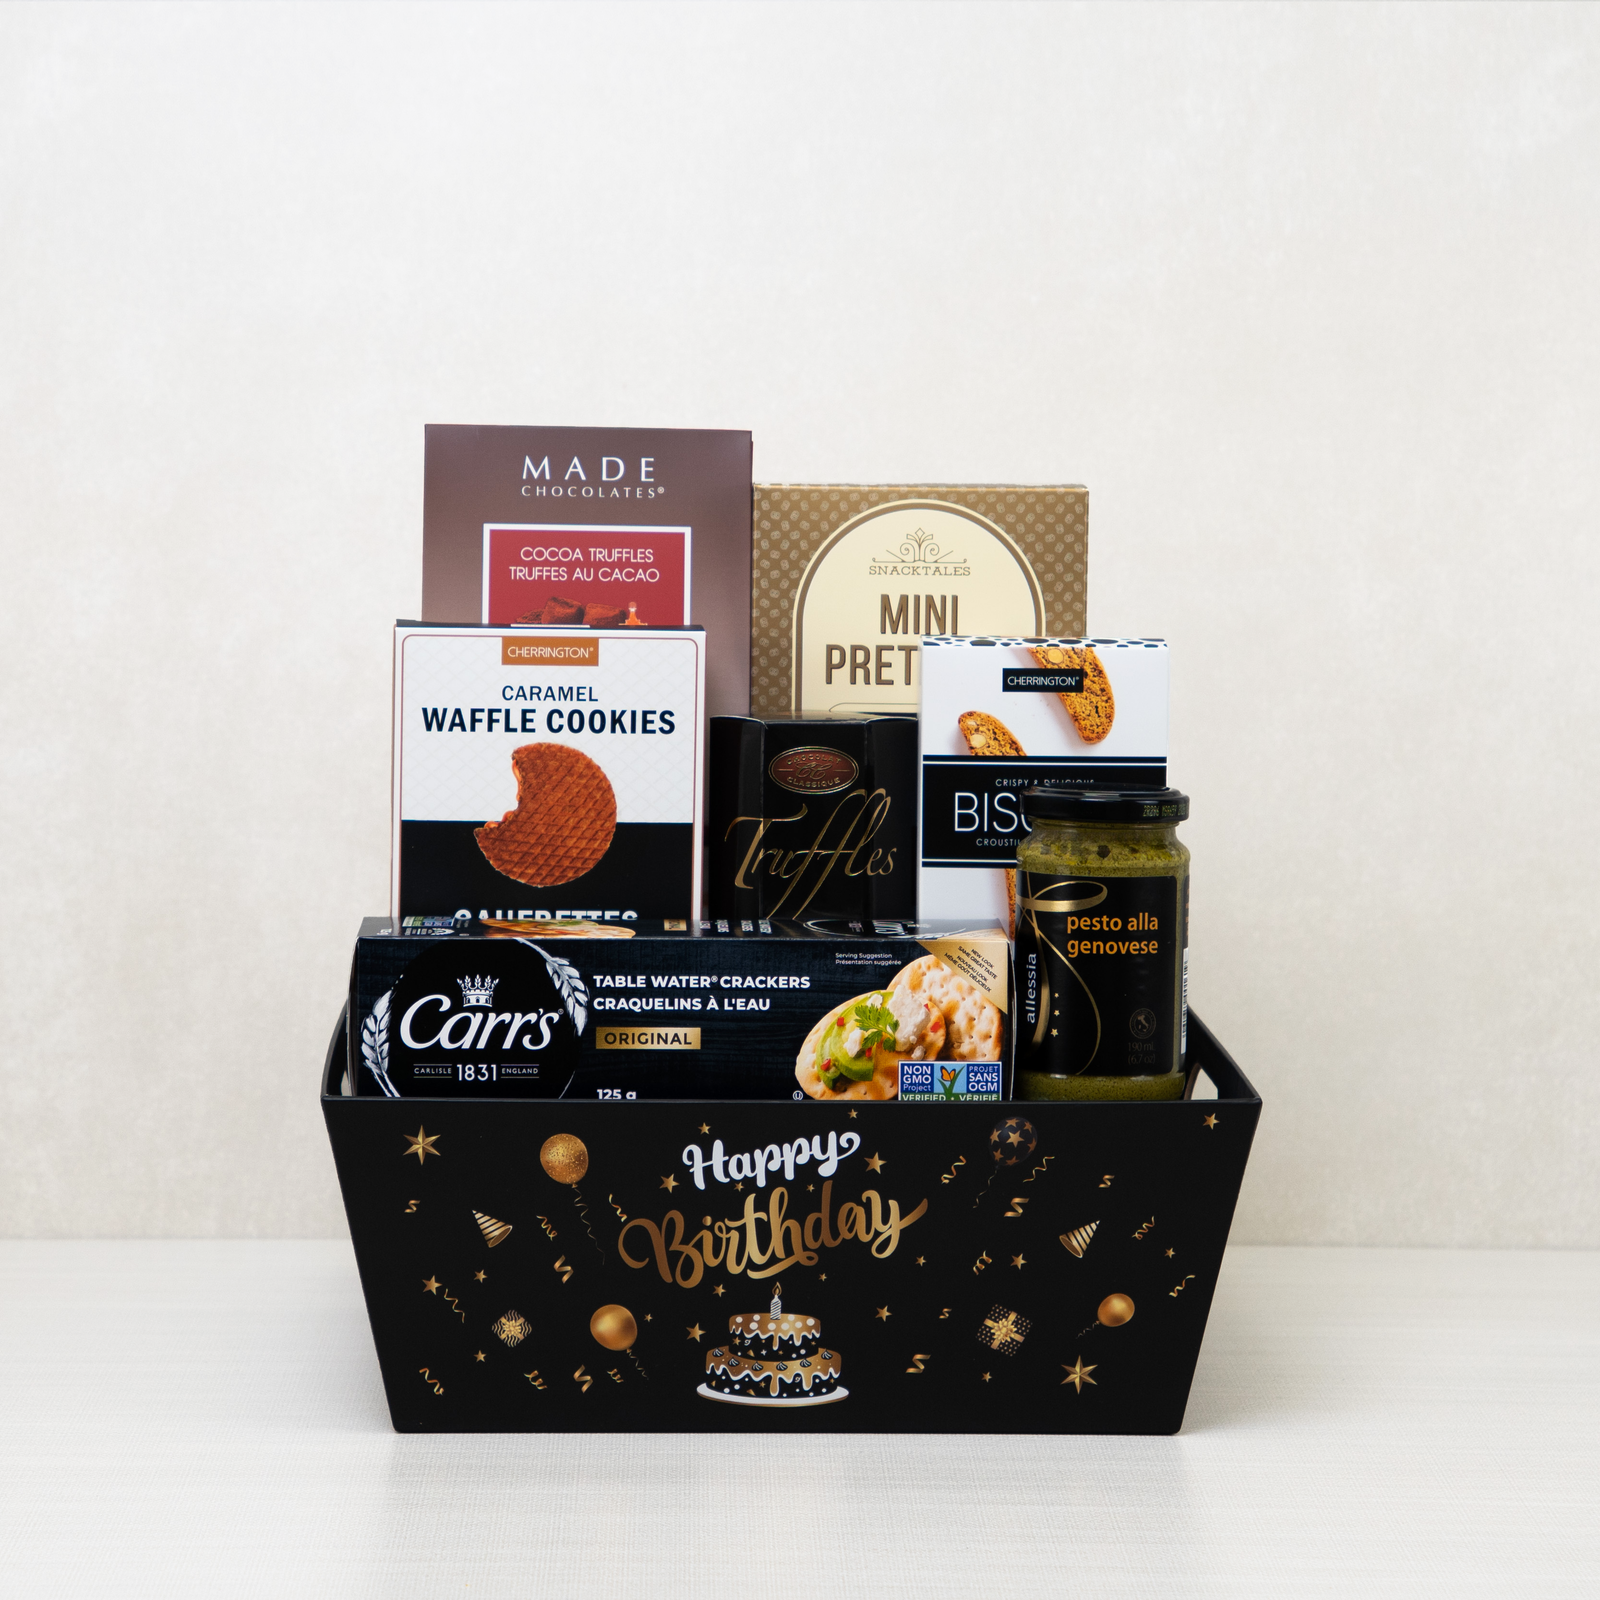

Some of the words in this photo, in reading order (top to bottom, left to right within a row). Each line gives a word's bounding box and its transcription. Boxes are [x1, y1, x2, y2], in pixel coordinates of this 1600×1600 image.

[522, 455, 655, 482] MADE
[521, 485, 656, 499] CHOCOLATES
[520, 547, 583, 562] COCOA
[589, 548, 654, 563] TRUFFLES
[509, 566, 568, 581] TRUFFES
[572, 567, 594, 581] AU
[598, 568, 660, 582] CACAO
[868, 565, 971, 576] SNACKTALES
[880, 593, 958, 635] MINI
[507, 646, 589, 658] CHERRINGTON
[1007, 676, 1076, 686] CHERRINGTON
[501, 685, 599, 702] CARAMEL
[421, 707, 537, 733] WAFFLE
[546, 708, 676, 735] COOKIES
[786, 776, 841, 788] CLASSIQUE
[995, 778, 1029, 787] CRISPY
[725, 788, 897, 920] Truffles
[1066, 914, 1122, 934] pesto
[1127, 912, 1159, 931] alla
[1066, 939, 1159, 958] genovese
[958, 946, 971, 958] SAME
[970, 956, 985, 969] GREAT
[984, 967, 998, 980] TASTE
[971, 949, 982, 959] NEW
[981, 957, 994, 969] LOOK
[956, 955, 977, 974] NOUVEAU
[976, 971, 988, 982] LOOK
[593, 975, 646, 988] TABLE
[651, 976, 711, 988] WATER
[720, 976, 811, 989] CRACKERS
[1026, 953, 1037, 1024] allessia
[593, 998, 702, 1012] CRAQUELINS
[706, 995, 719, 1010] À
[724, 998, 770, 1010] L'EAU
[400, 994, 560, 1050] Carr's
[604, 1032, 692, 1045] ORIGINAL
[1128, 1041, 1142, 1052] 190
[456, 1064, 497, 1081] 1831
[903, 1065, 931, 1074] NON
[968, 1072, 998, 1082] SANS
[903, 1075, 932, 1084] GMO
[968, 1082, 998, 1091] OGM
[597, 1088, 622, 1099] 125
[903, 1083, 931, 1093] Project
[682, 1131, 861, 1190] Happy
[618, 1180, 928, 1289] Birthday
